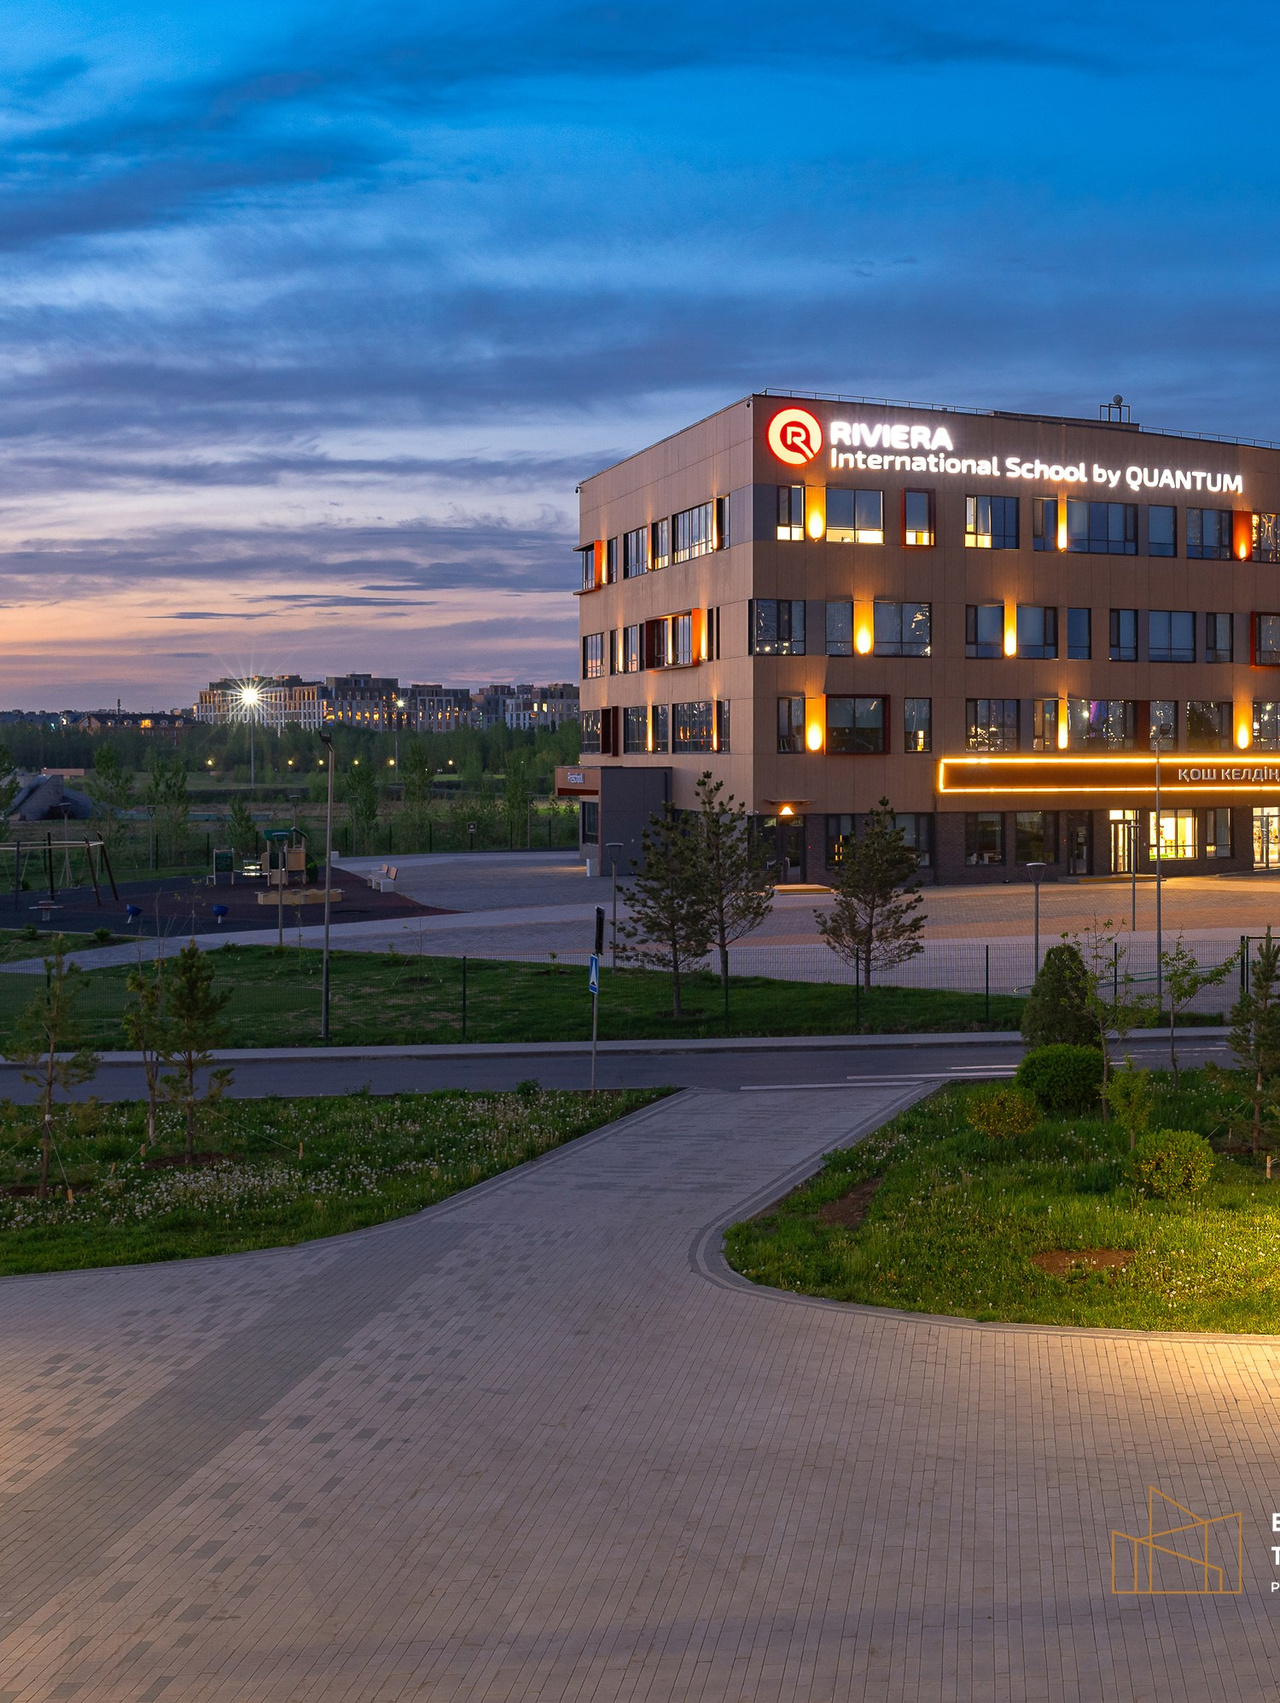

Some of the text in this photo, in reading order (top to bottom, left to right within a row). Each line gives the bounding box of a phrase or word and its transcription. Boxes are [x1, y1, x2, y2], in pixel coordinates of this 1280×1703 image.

[830, 421, 954, 451] RIVIERA
[831, 447, 1244, 494] International School by QUANTUM
[1178, 768, 1217, 782] ҚОШ
